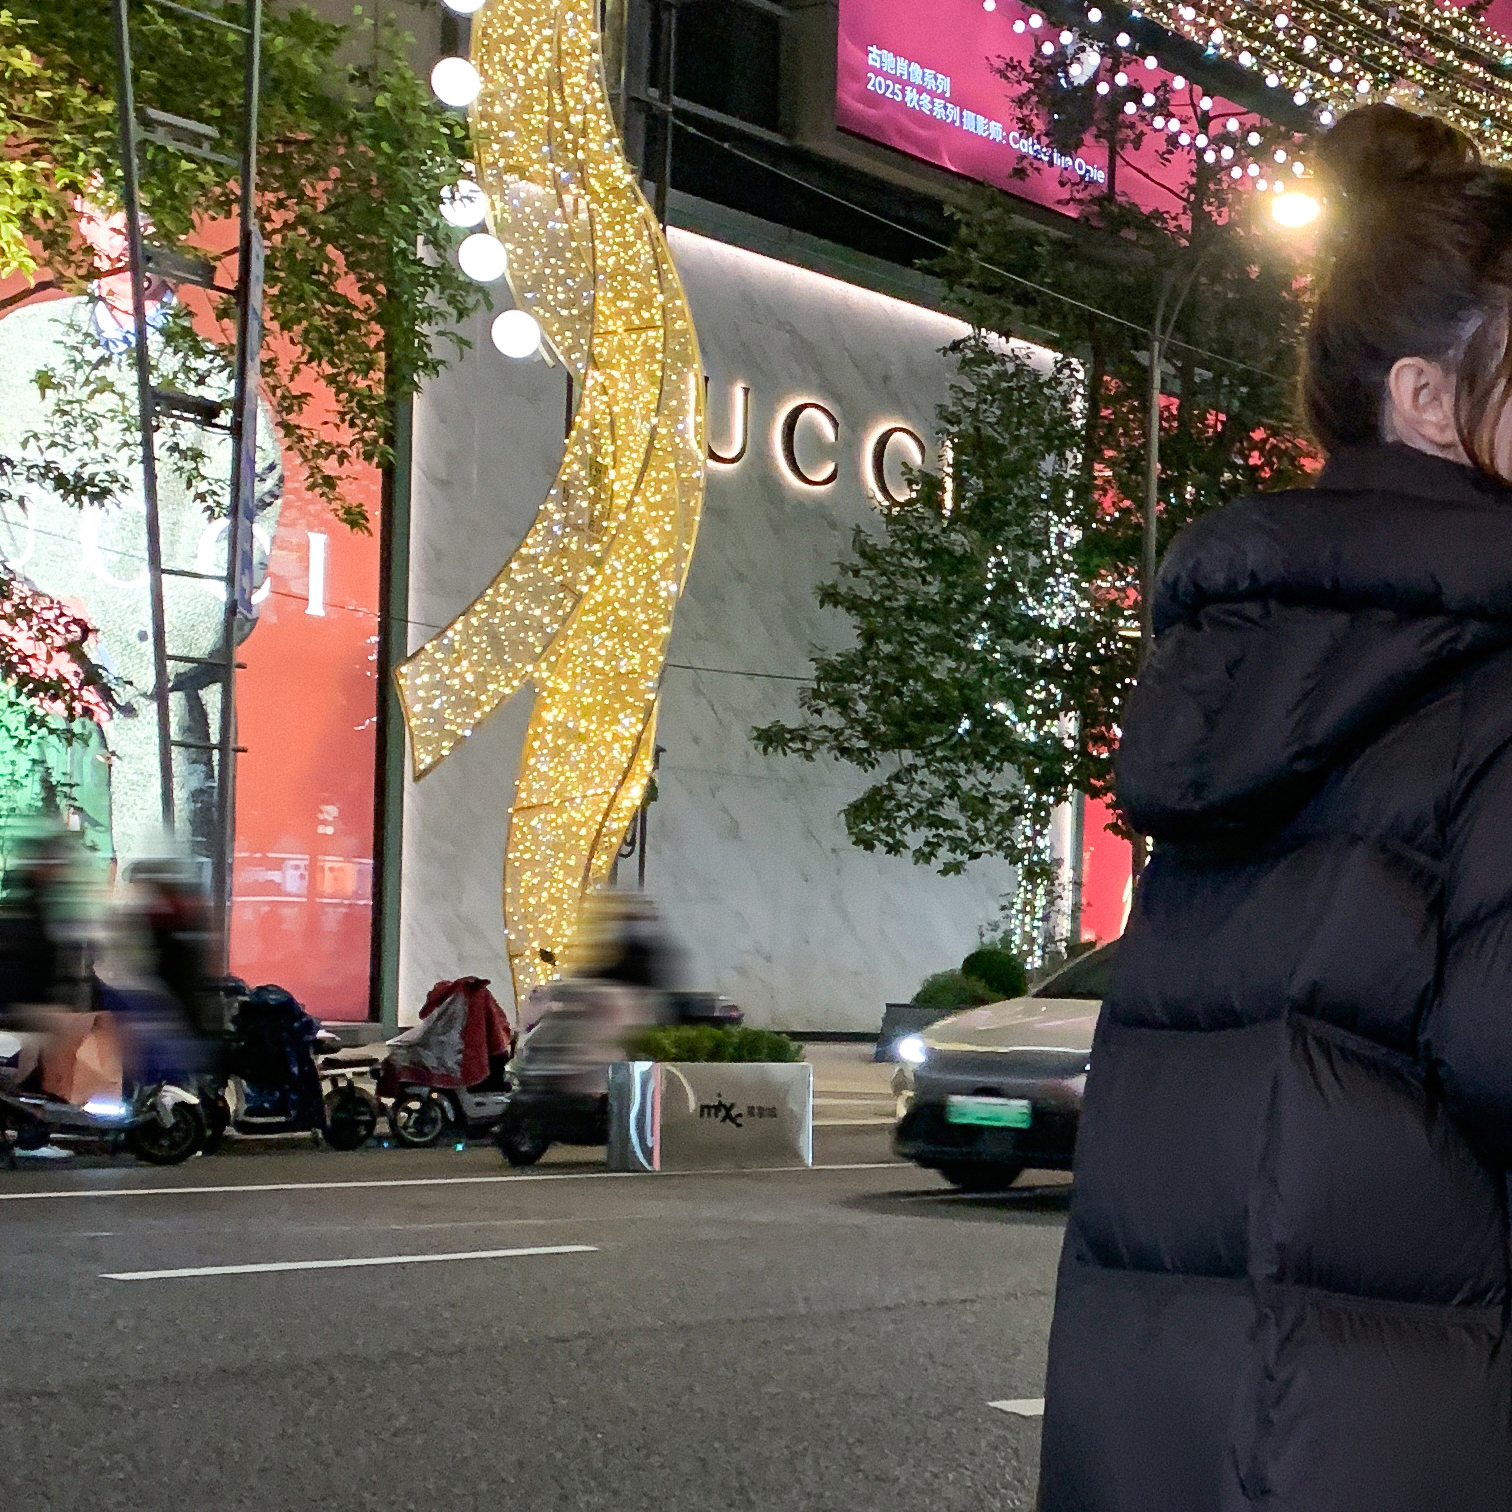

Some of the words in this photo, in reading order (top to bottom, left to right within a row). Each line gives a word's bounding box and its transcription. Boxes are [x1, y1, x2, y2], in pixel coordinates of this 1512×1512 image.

[867, 44, 951, 98] 古驰肖像系列
[867, 72, 903, 102] 2025
[904, 86, 960, 127] 秋冬系列
